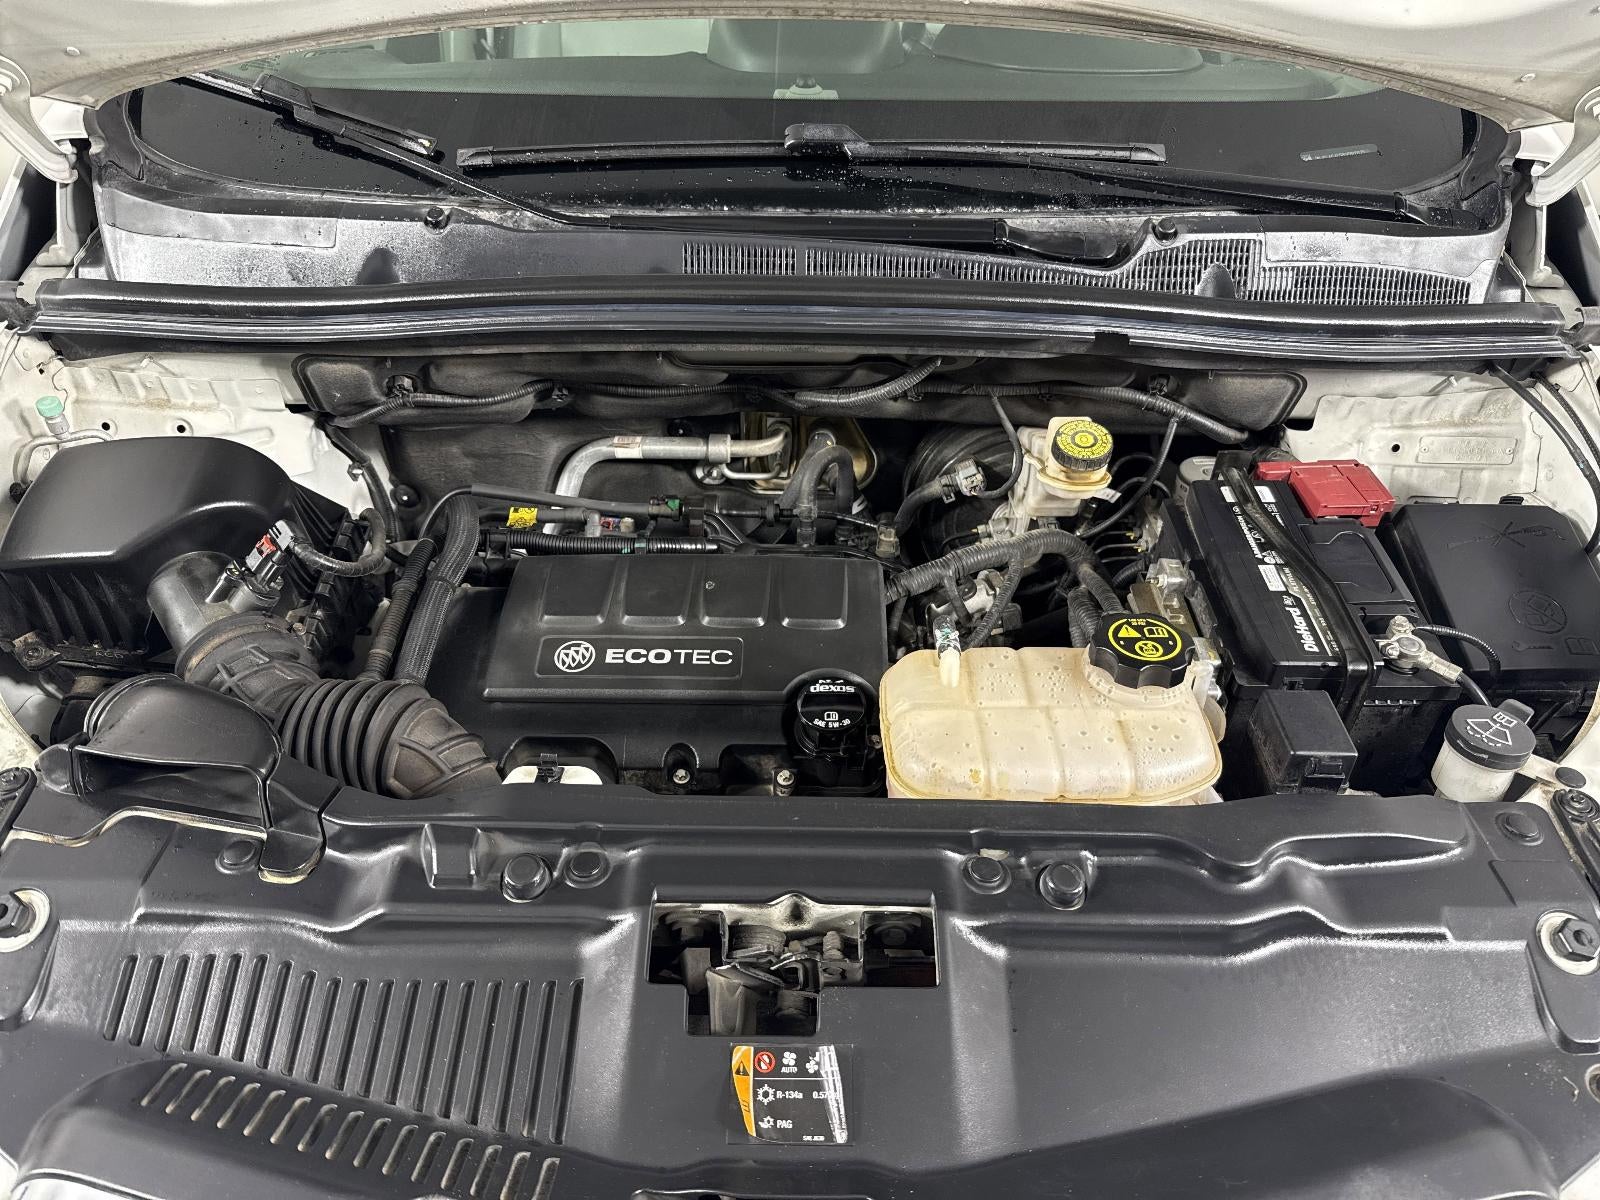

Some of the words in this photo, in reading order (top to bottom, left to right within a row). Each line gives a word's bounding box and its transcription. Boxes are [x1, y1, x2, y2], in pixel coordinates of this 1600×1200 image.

[1285, 606, 1320, 653] DieHard
[605, 648, 733, 665] ECOTEC
[810, 683, 856, 693] dexos
[776, 1091, 803, 1099] R-134a
[777, 1119, 793, 1129] PAG
